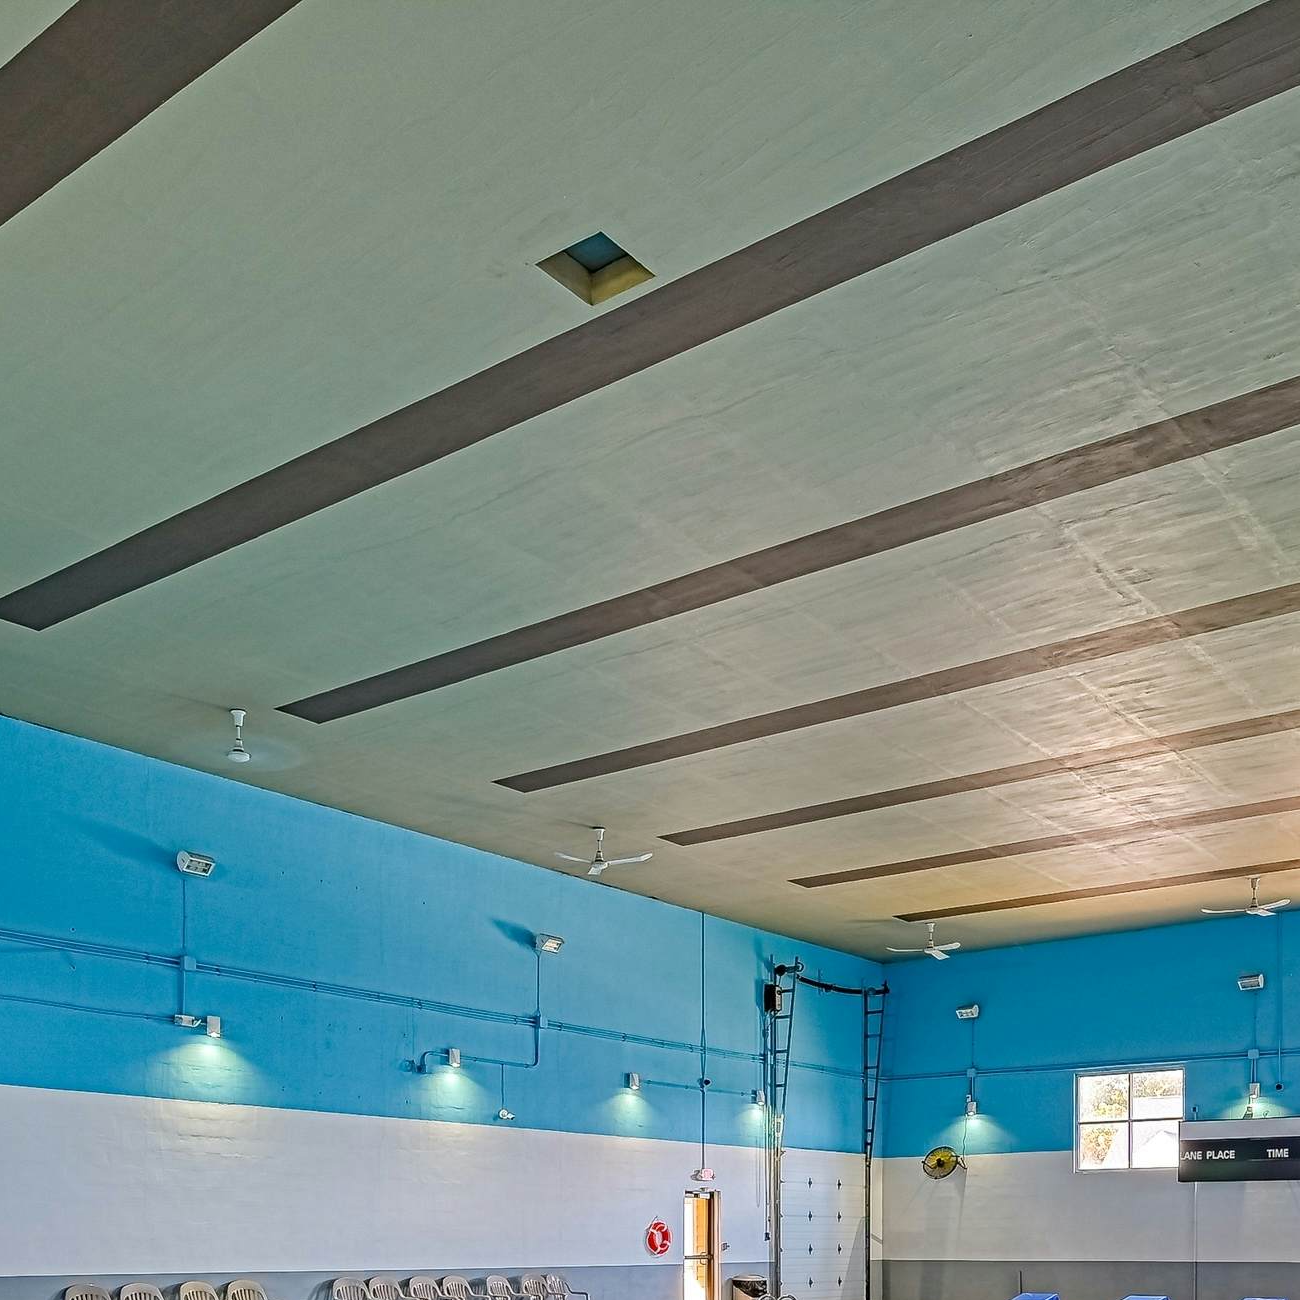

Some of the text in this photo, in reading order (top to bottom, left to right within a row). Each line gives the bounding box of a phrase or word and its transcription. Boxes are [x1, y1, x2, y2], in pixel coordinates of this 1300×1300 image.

[1180, 1149, 1289, 1160] LANE PLACE TIME
